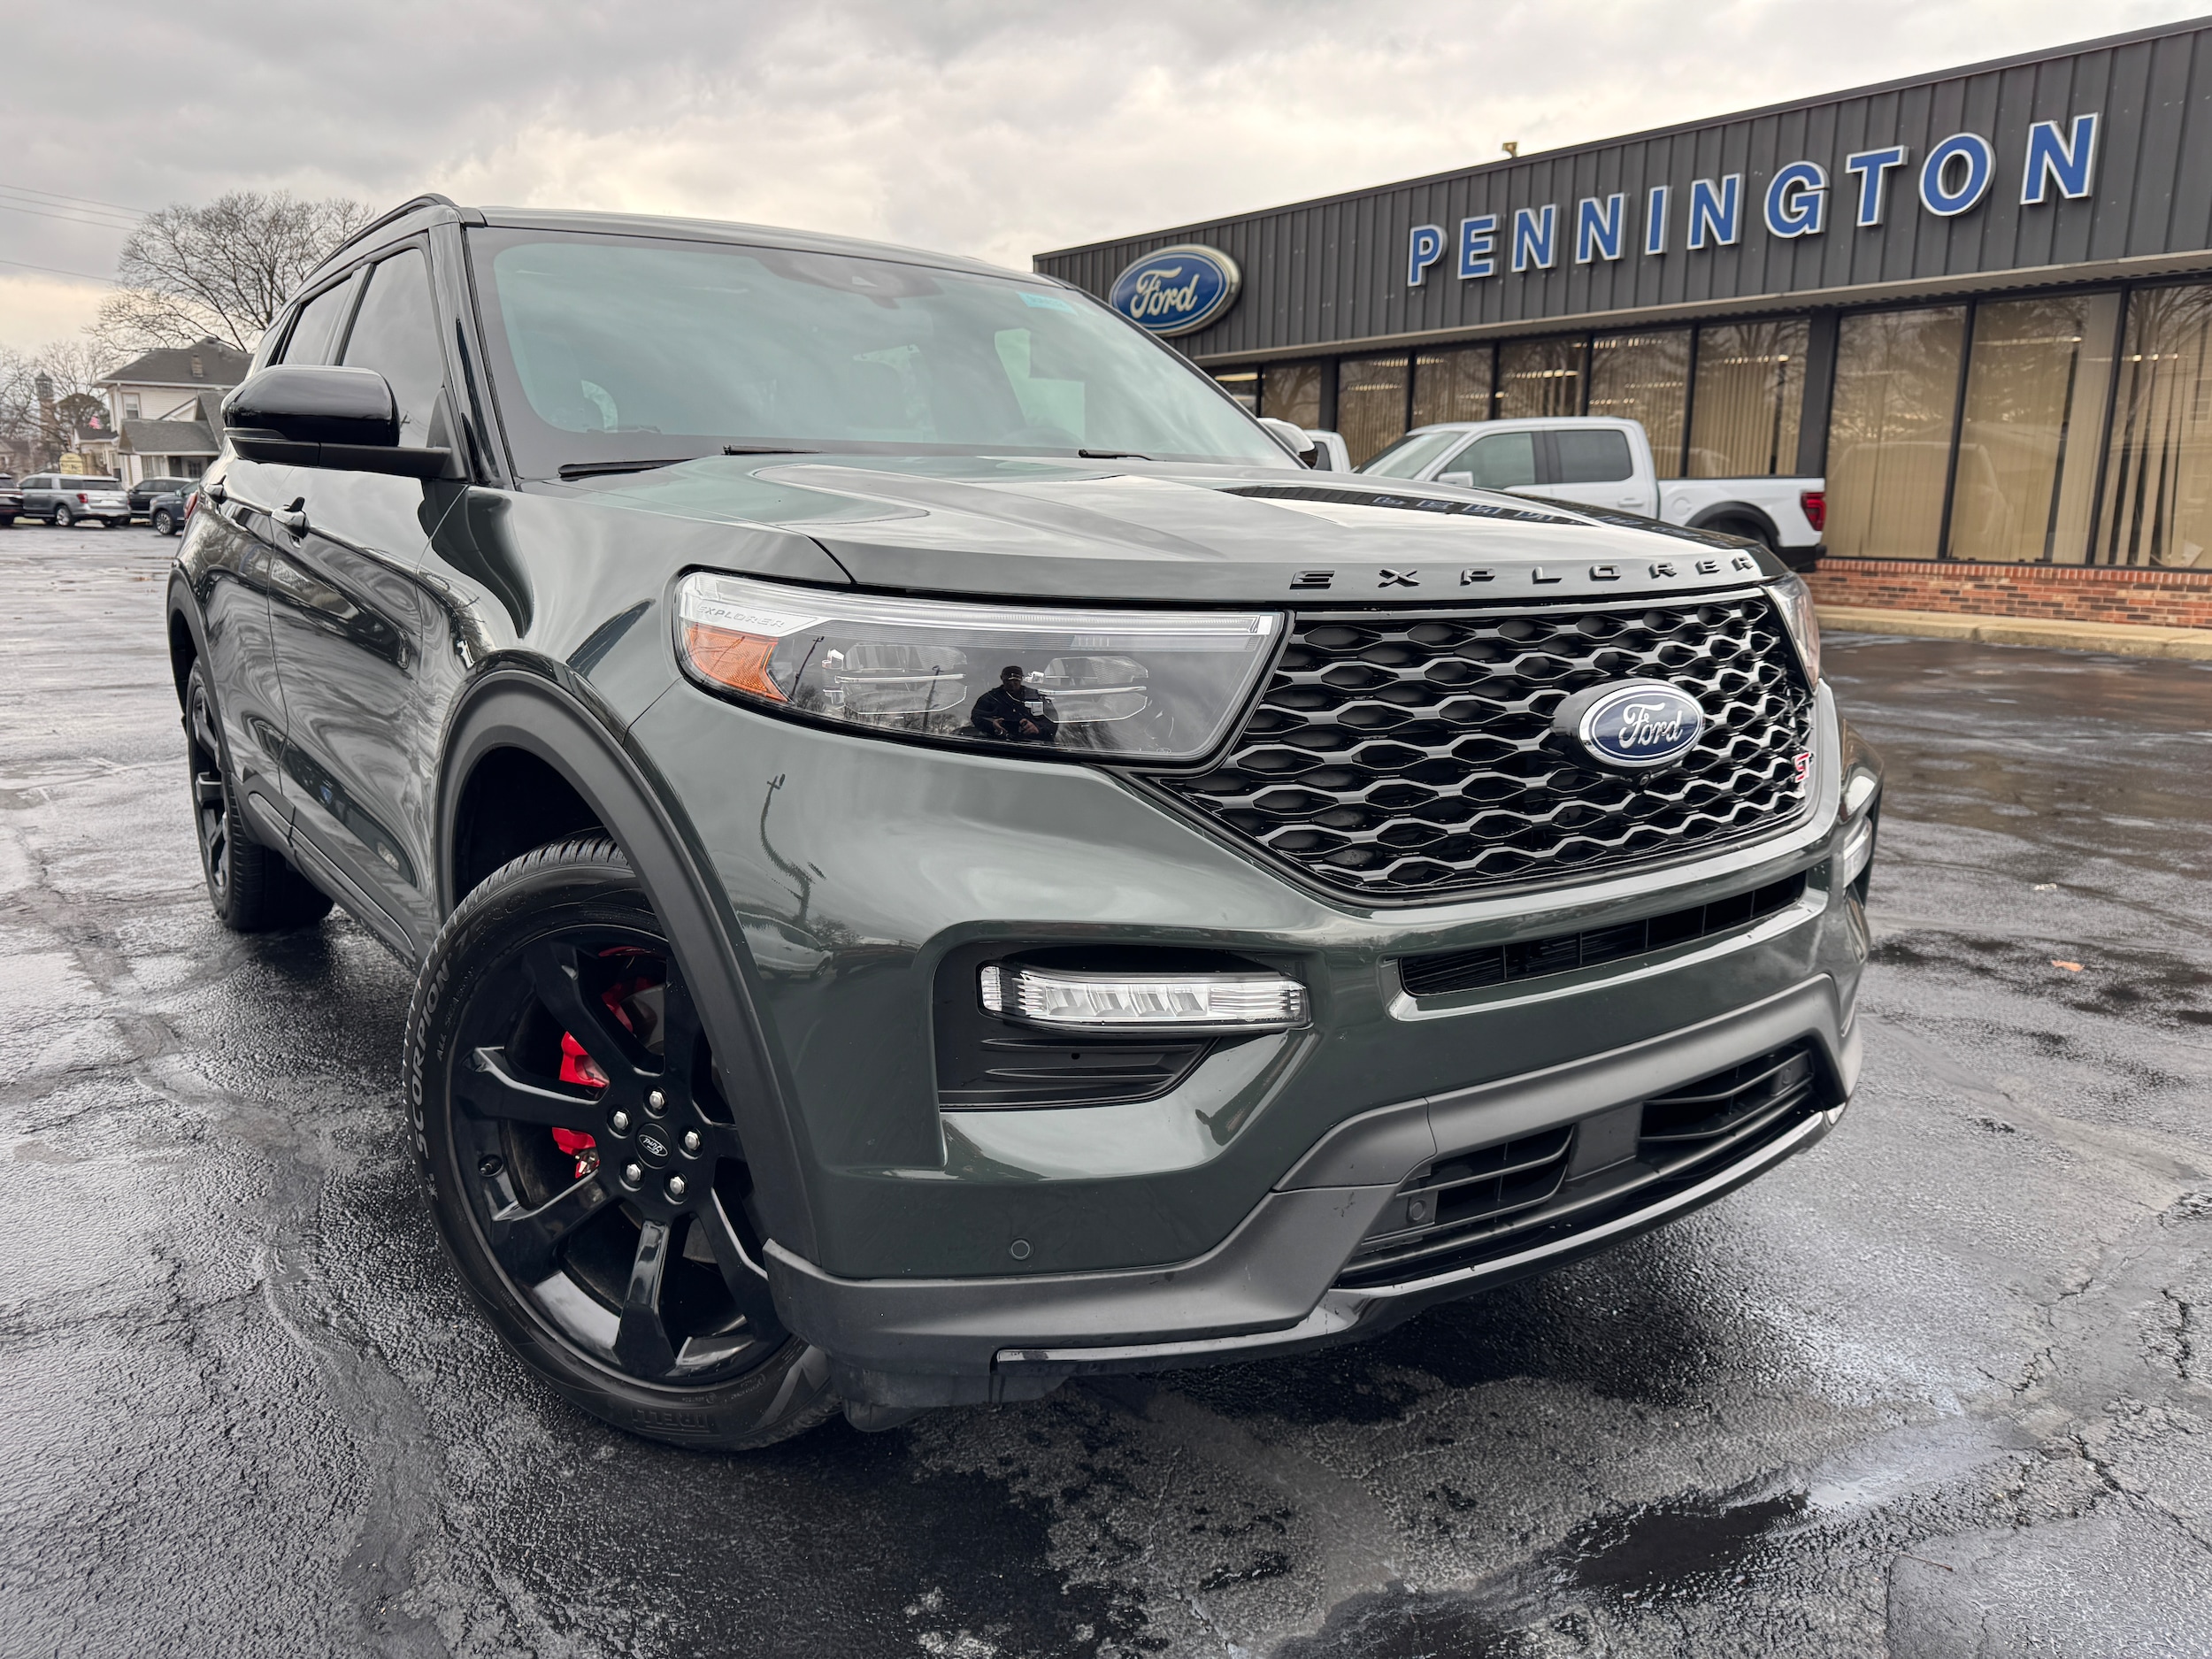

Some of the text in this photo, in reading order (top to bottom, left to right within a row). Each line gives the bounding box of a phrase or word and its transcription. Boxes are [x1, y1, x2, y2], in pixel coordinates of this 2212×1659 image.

[1407, 111, 2100, 287] PENNINGTON
[1129, 265, 1201, 319] Ford
[1289, 553, 1754, 590] EXPLORER
[696, 605, 786, 628] EXPLORER
[1617, 701, 1684, 749] Ford
[411, 961, 450, 1160] SCORPION
